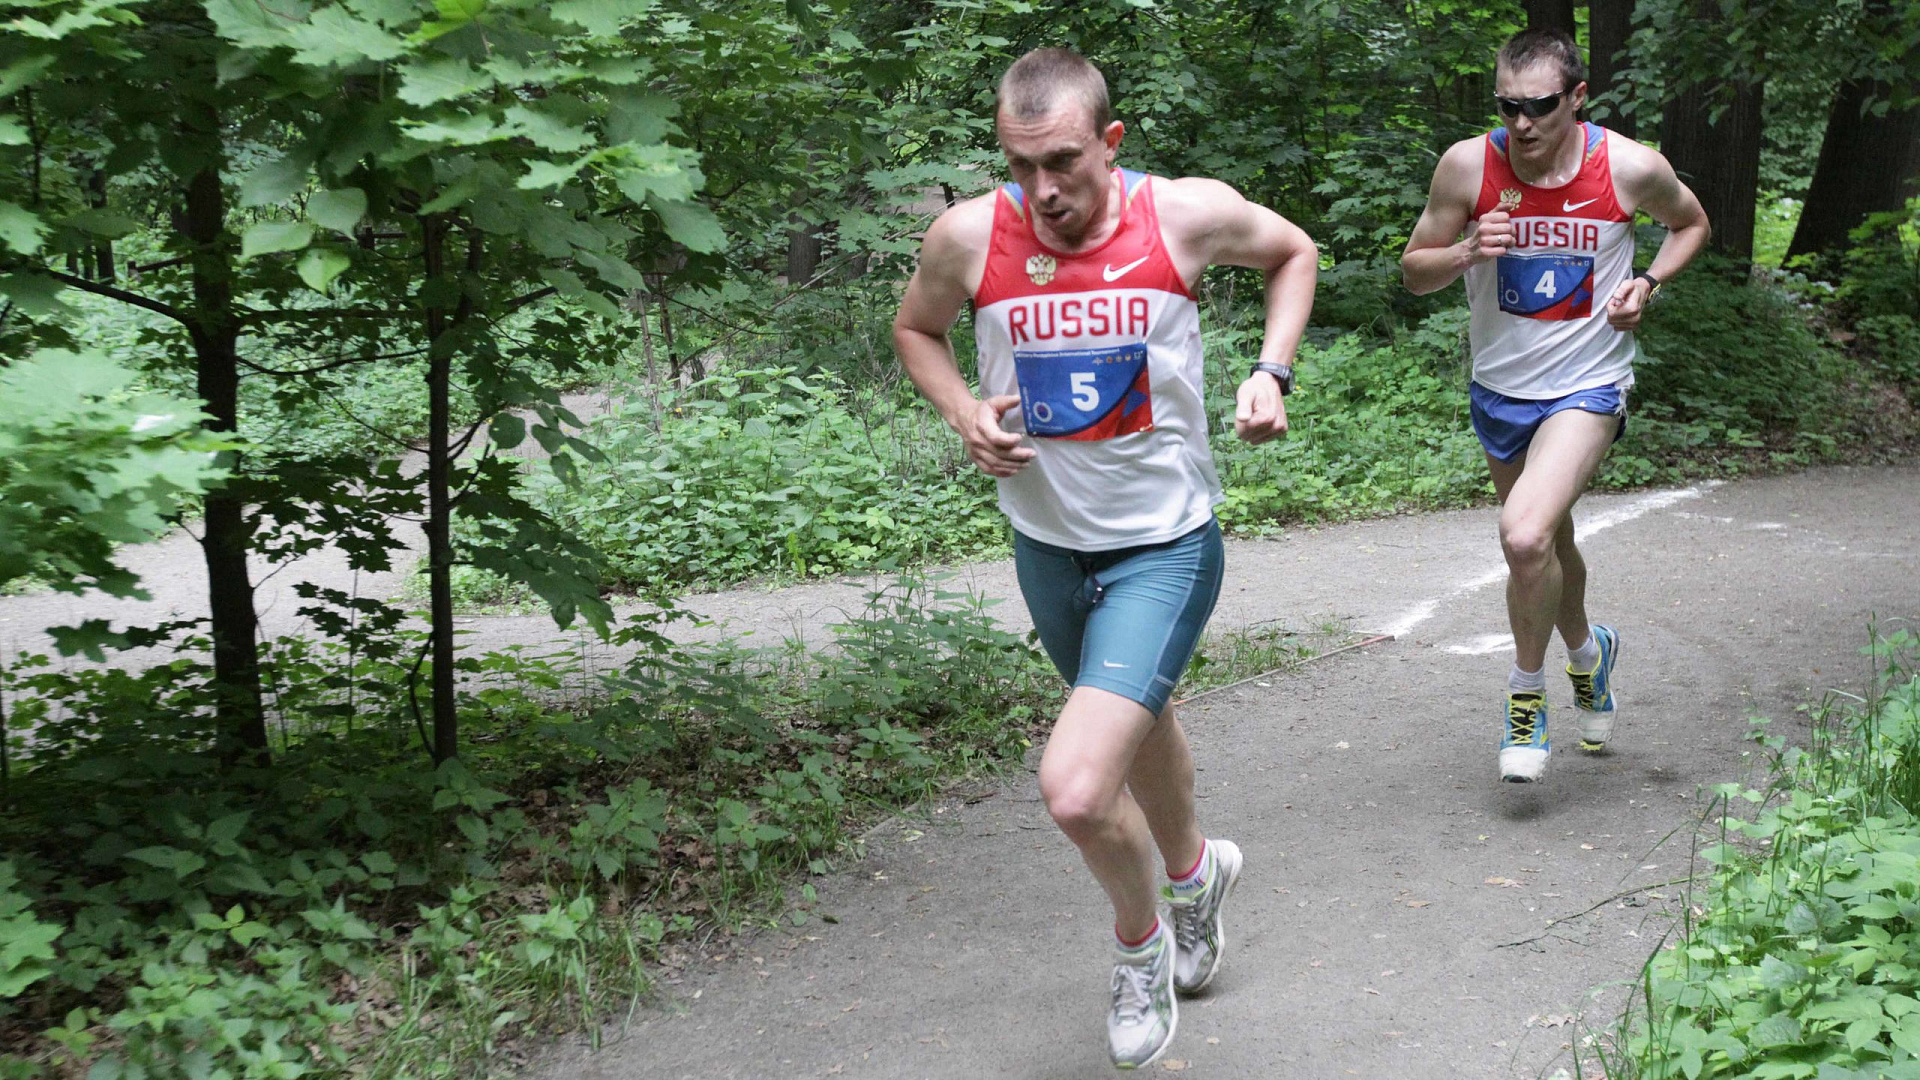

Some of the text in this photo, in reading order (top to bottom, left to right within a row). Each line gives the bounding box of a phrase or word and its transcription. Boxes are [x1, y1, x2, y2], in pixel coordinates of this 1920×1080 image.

[1514, 220, 1599, 252] USSIA
[1533, 270, 1557, 299] 4
[1008, 296, 1149, 346] RUSSIA
[1069, 371, 1100, 412] 5
